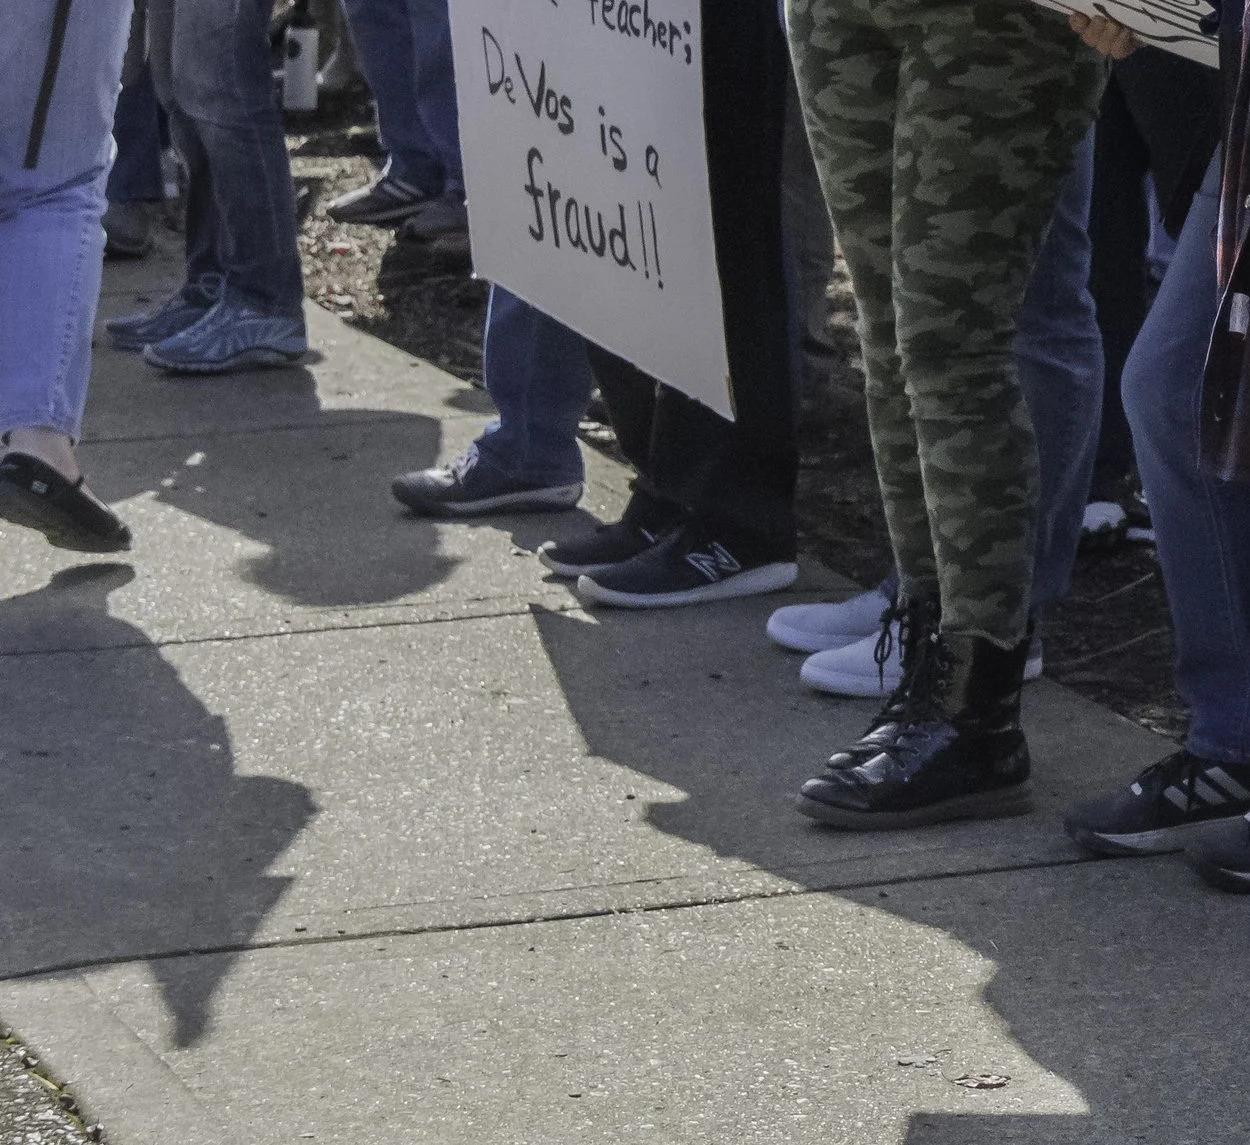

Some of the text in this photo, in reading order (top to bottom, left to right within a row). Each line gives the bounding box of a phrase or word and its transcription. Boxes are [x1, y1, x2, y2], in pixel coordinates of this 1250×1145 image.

[481, 26, 662, 189] DeVos is a
[524, 147, 665, 290] fraud!!
